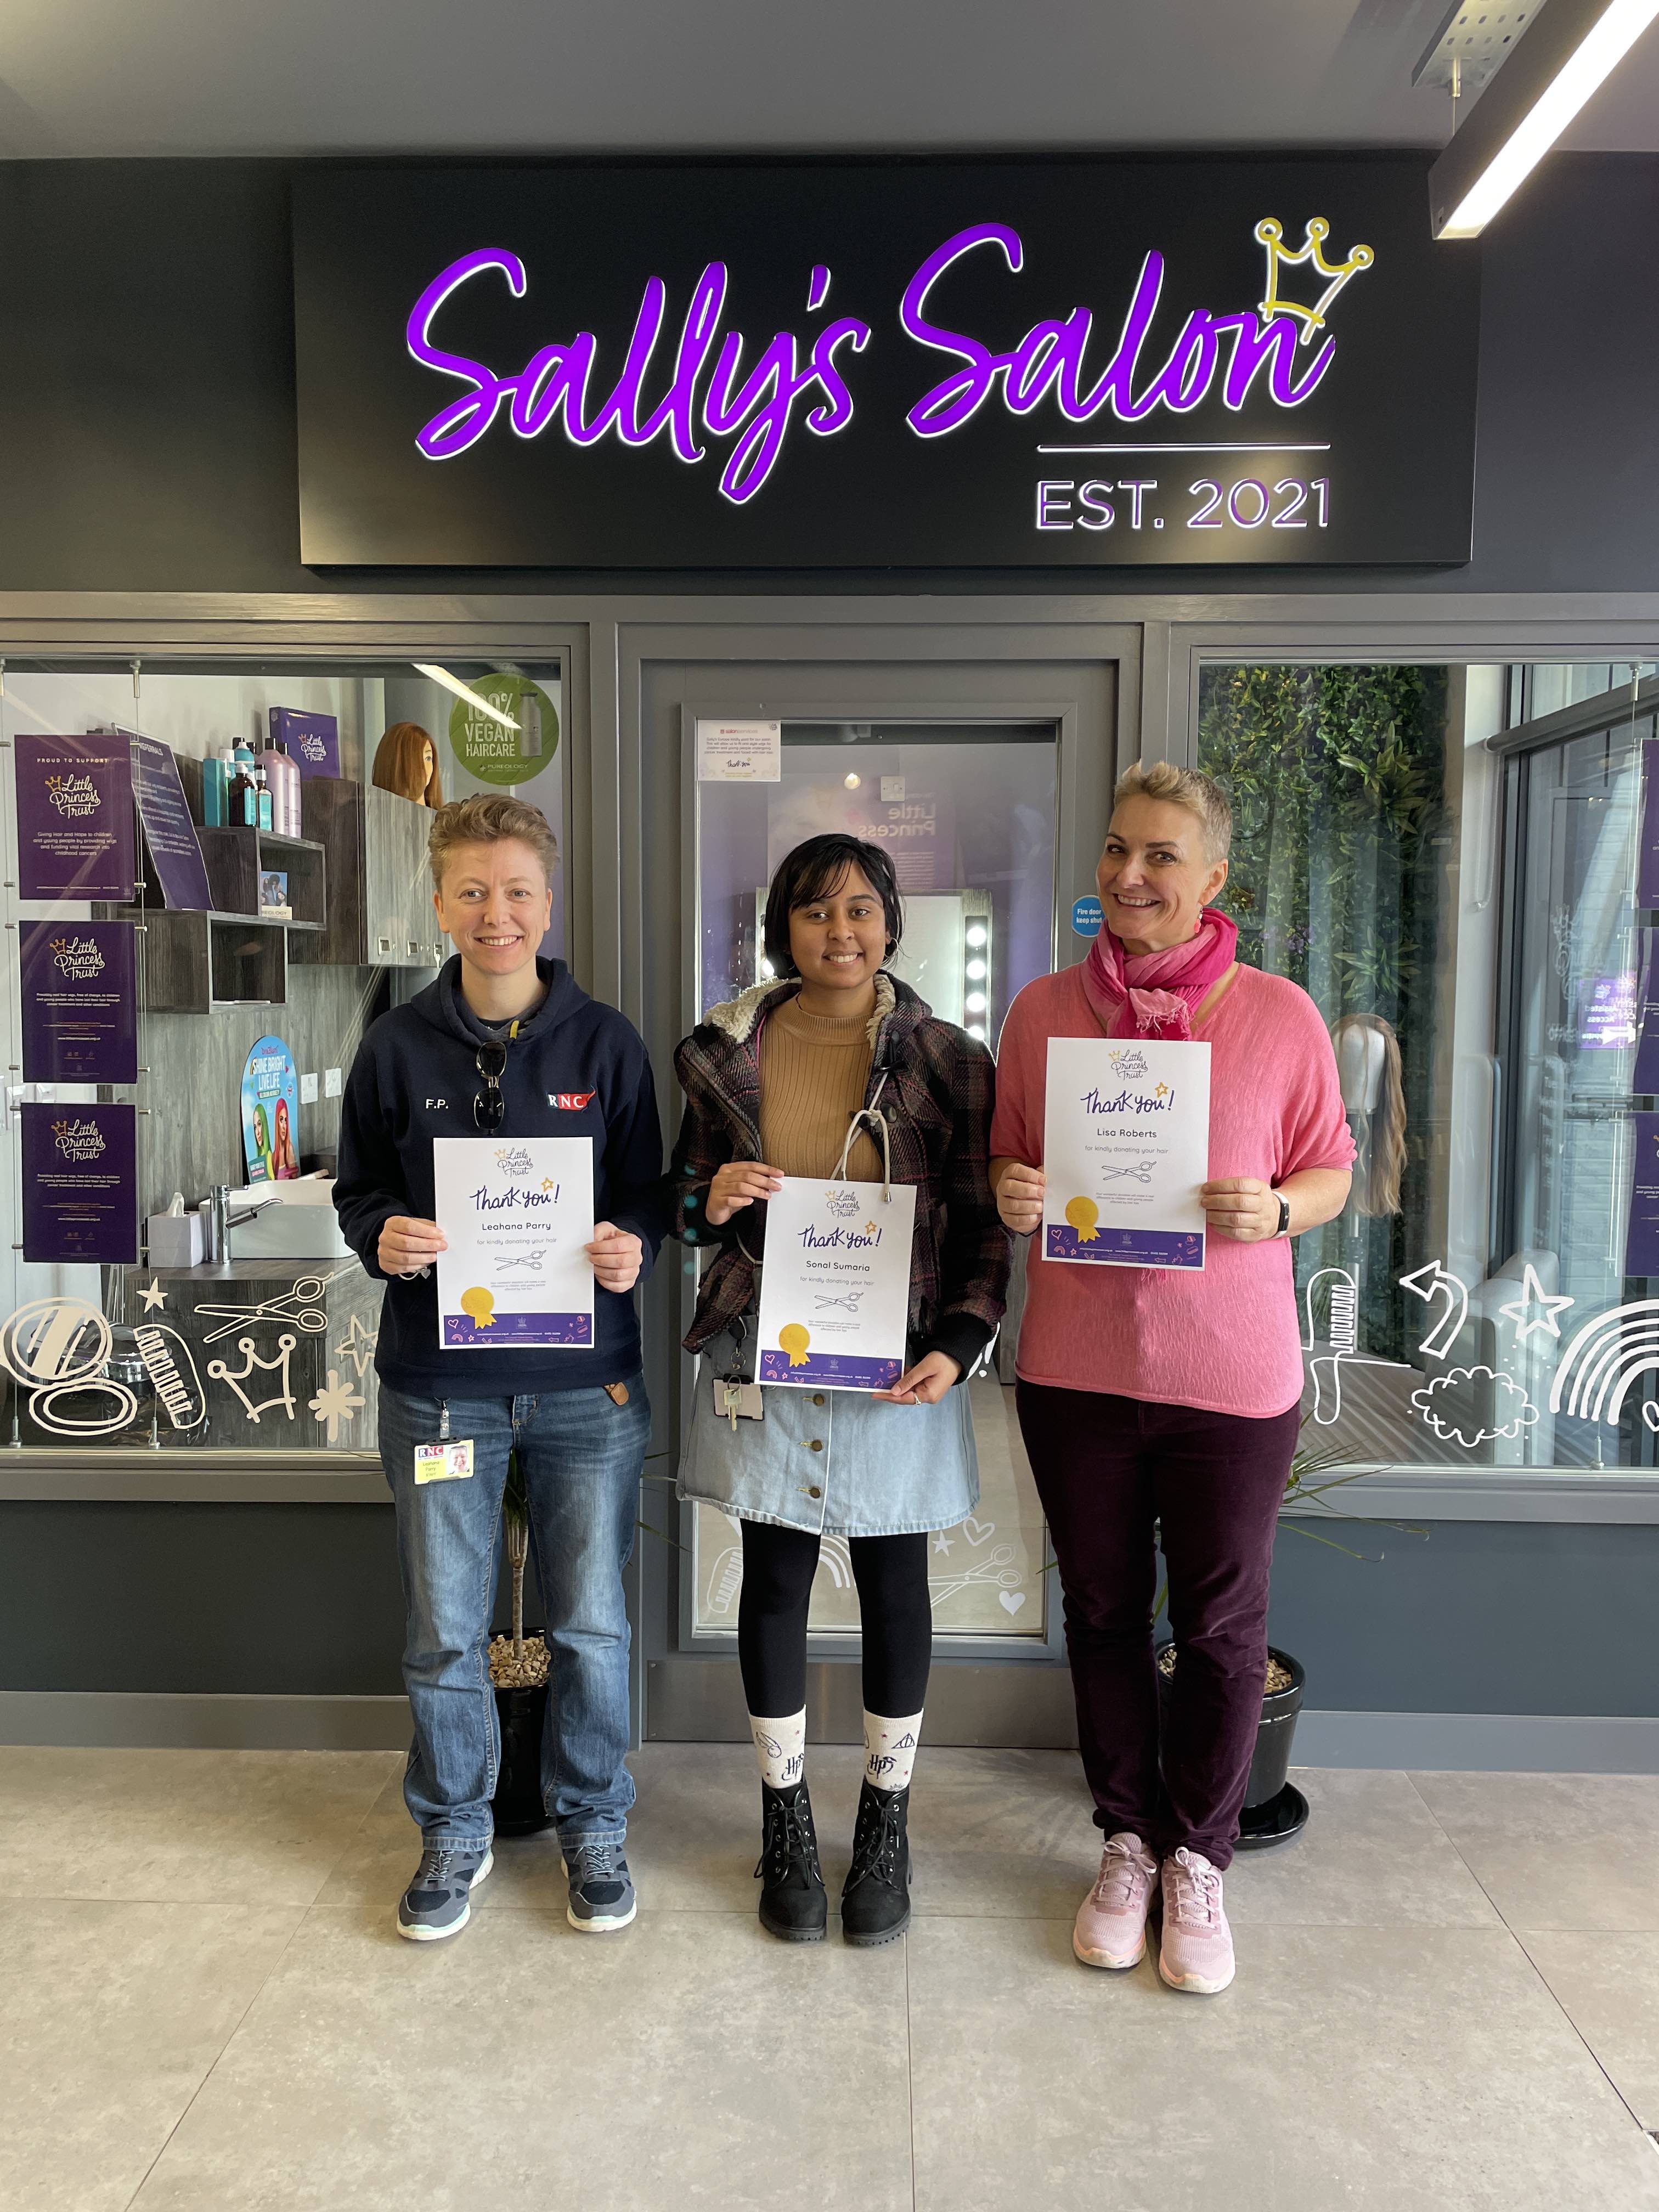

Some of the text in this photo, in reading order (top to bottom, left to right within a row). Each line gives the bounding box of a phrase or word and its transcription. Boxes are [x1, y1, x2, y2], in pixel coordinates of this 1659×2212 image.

[407, 222, 1336, 504] Sally's Salon
[1036, 478, 1330, 530] EST. 2021
[467, 693, 515, 721] 100%
[307, 733, 323, 746] Little
[465, 723, 515, 742] VEGAN
[301, 744, 326, 755] Princess
[466, 743, 515, 757] HAIRCARE
[306, 752, 324, 762] Trust
[61, 774, 93, 792] Little
[49, 790, 101, 810] Princess
[59, 802, 94, 819] Trust
[66, 937, 98, 954] Little
[54, 952, 105, 972] Princess
[64, 965, 99, 981] Trust
[1120, 1049, 1143, 1062] Little
[252, 1055, 286, 1075] SHINE BRIGHT
[1111, 1061, 1148, 1074] Princess
[1118, 1070, 1143, 1080] Trust
[425, 1098, 449, 1109] F.P.
[548, 1094, 584, 1108] RNC
[1080, 1087, 1133, 1114] Thank
[67, 1119, 99, 1136] Little
[1097, 1128, 1157, 1138] Lisa Roberts
[55, 1135, 106, 1154] Princess
[65, 1147, 99, 1162] Trust
[506, 1148, 528, 1160] Little
[498, 1159, 533, 1171] Princess
[504, 1167, 529, 1177] Trust
[470, 1185, 521, 1210] Thank
[835, 1190, 856, 1201] Little
[826, 1200, 860, 1212] Princess
[832, 1209, 855, 1218] Trust
[526, 1222, 551, 1231] Parry
[798, 1224, 845, 1248] Thank
[806, 1261, 870, 1272] Sonal Sumaria
[419, 1447, 443, 1457] RNC
